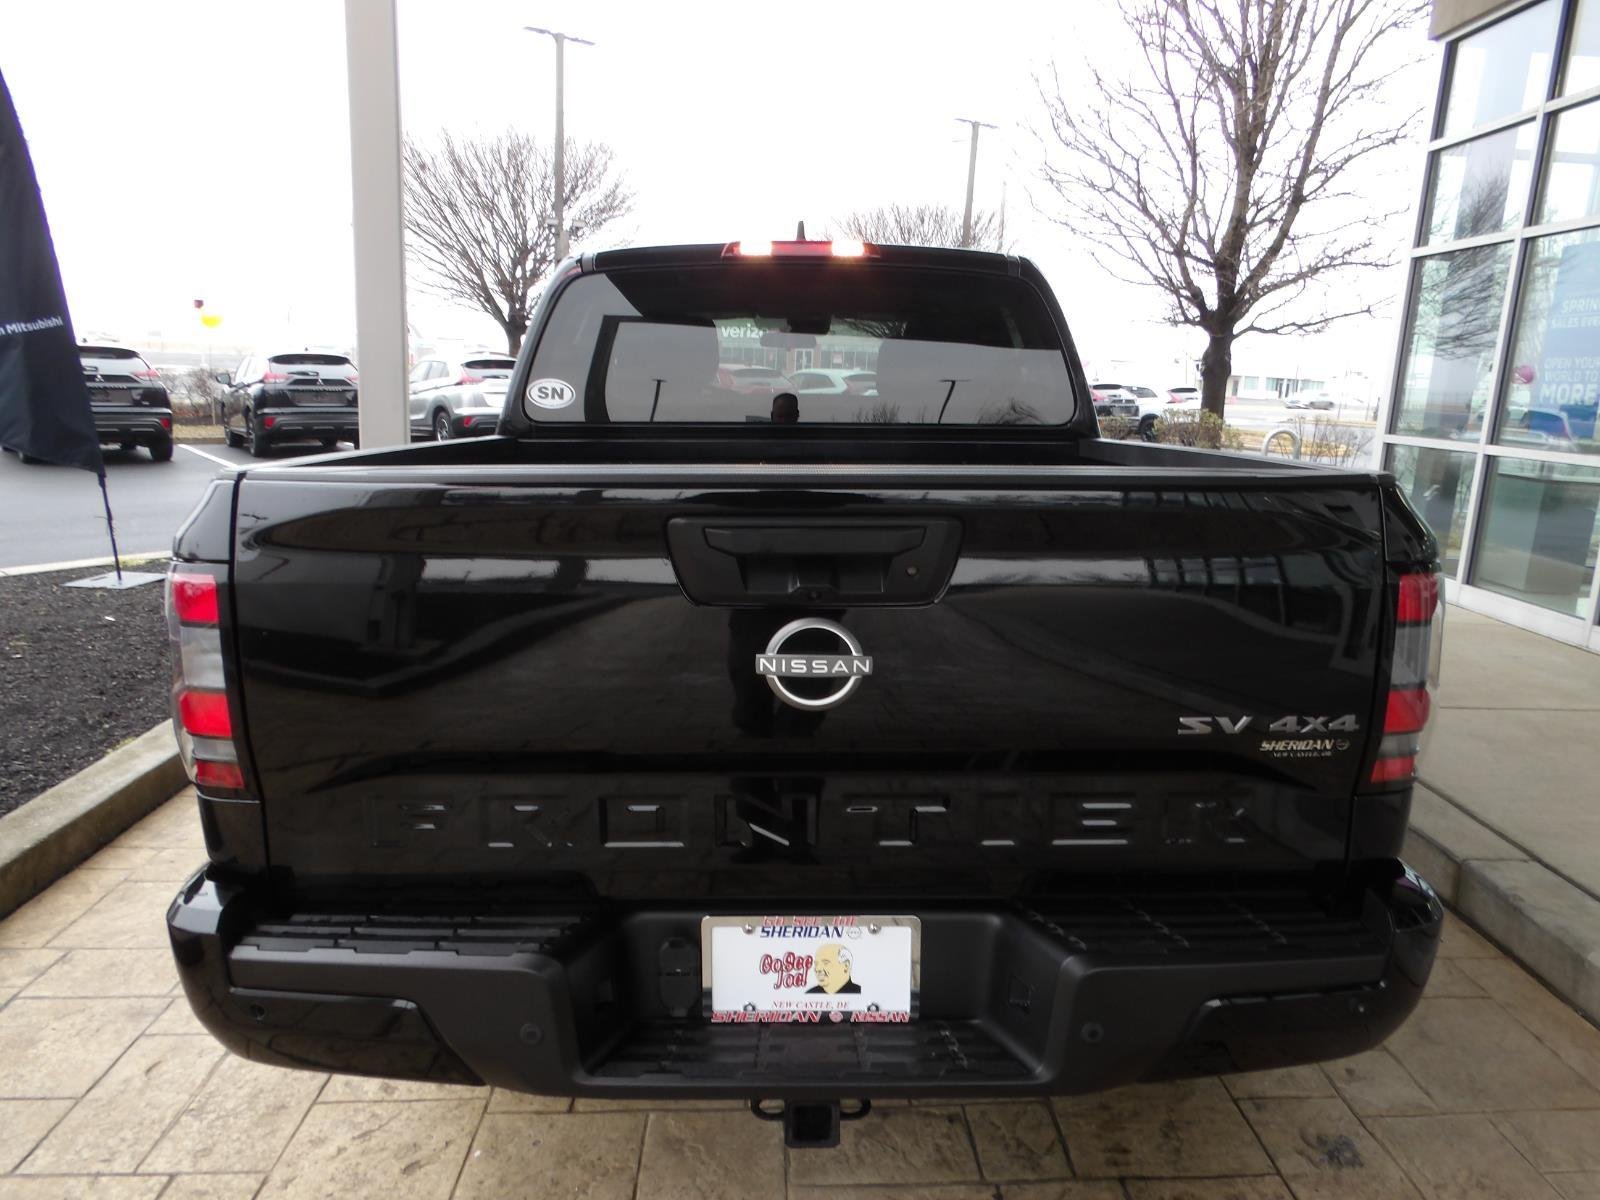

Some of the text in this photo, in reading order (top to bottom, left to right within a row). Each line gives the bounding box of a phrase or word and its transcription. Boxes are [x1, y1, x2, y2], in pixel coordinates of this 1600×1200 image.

[1561, 299, 1600, 314] SPRIN
[6, 316, 63, 335] Mitsubishi
[537, 386, 564, 400] SN
[1539, 383, 1599, 405] MORE
[759, 657, 870, 674] NISSAN
[1178, 715, 1253, 735] SV
[1259, 739, 1335, 751] SHERIDAN
[371, 795, 1255, 850] FRONTIER
[760, 925, 844, 938] SHERIDAN
[771, 1000, 791, 1010] NEW
[836, 1000, 849, 1010] DE
[711, 1011, 910, 1023] SHERIDAN NISSAN
